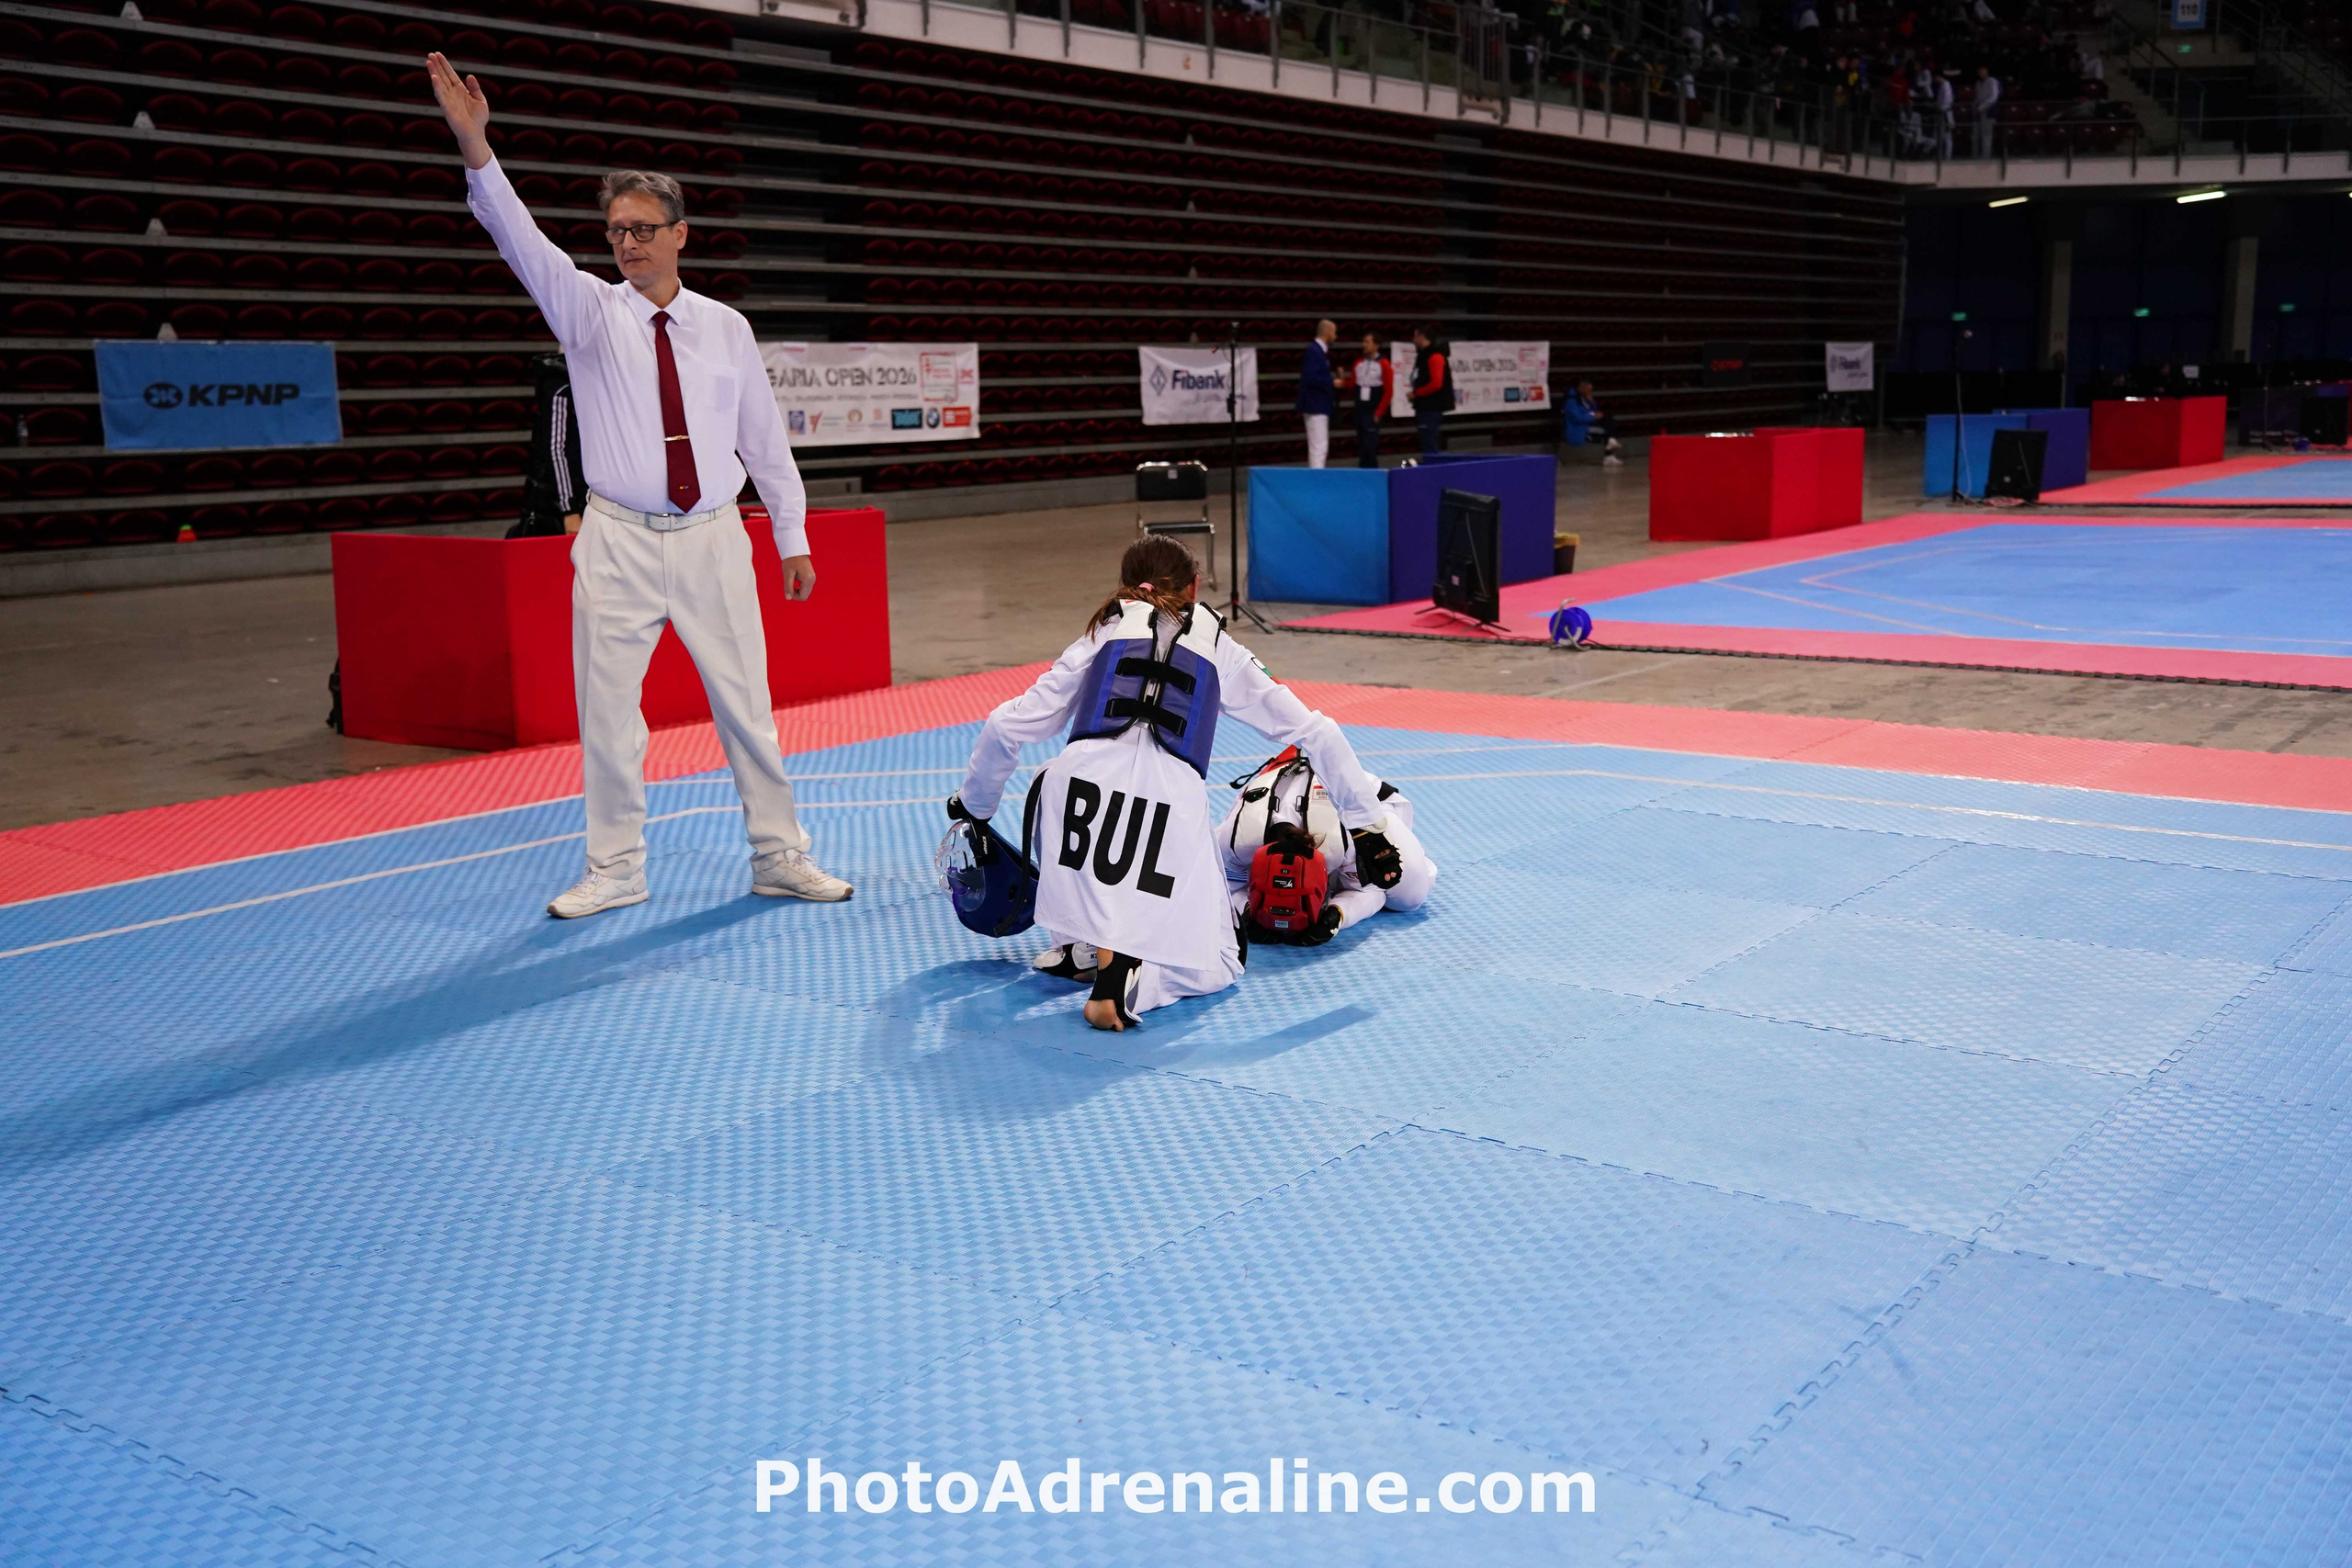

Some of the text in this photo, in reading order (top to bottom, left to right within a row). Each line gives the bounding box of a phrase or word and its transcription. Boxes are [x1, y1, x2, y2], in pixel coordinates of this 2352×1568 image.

[766, 367, 820, 388] GARIA
[825, 367, 872, 388] OPEN
[1171, 369, 1226, 390] Fibank
[188, 384, 300, 407] KPNP
[1058, 776, 1175, 899] BUL
